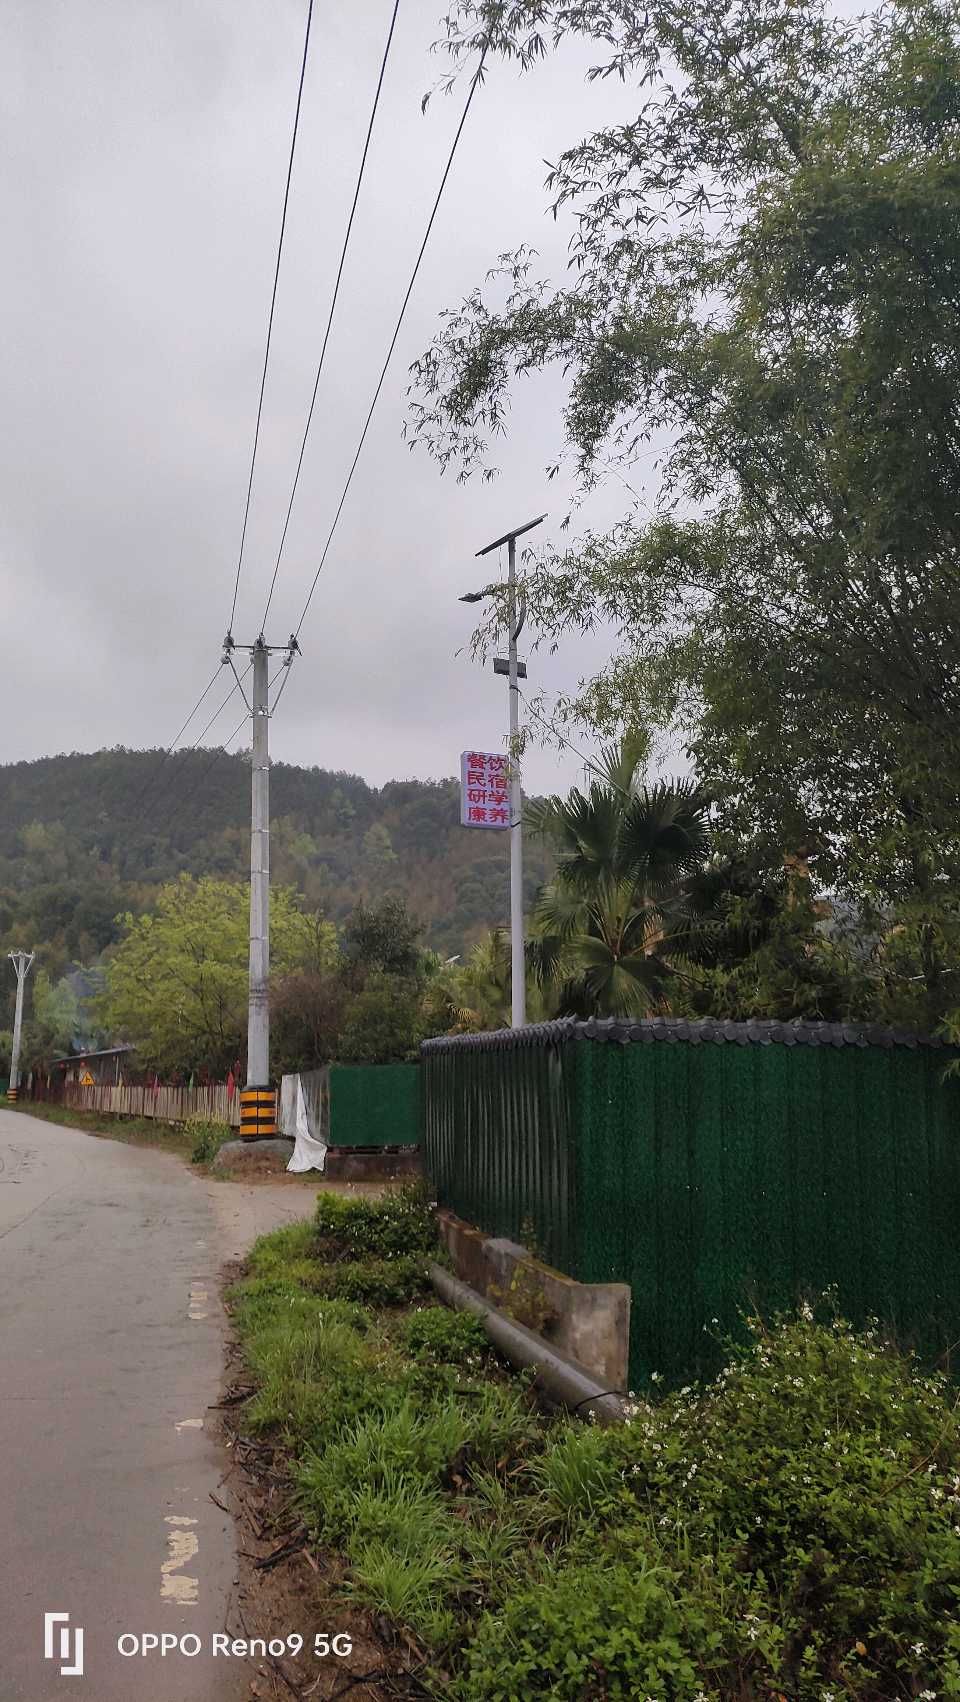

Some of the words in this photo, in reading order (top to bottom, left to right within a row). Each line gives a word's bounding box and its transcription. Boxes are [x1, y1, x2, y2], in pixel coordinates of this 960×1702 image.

[467, 753, 506, 771] 餐饮
[467, 771, 508, 789] 民宿
[467, 789, 509, 806] 研学
[468, 806, 509, 823] 康养
